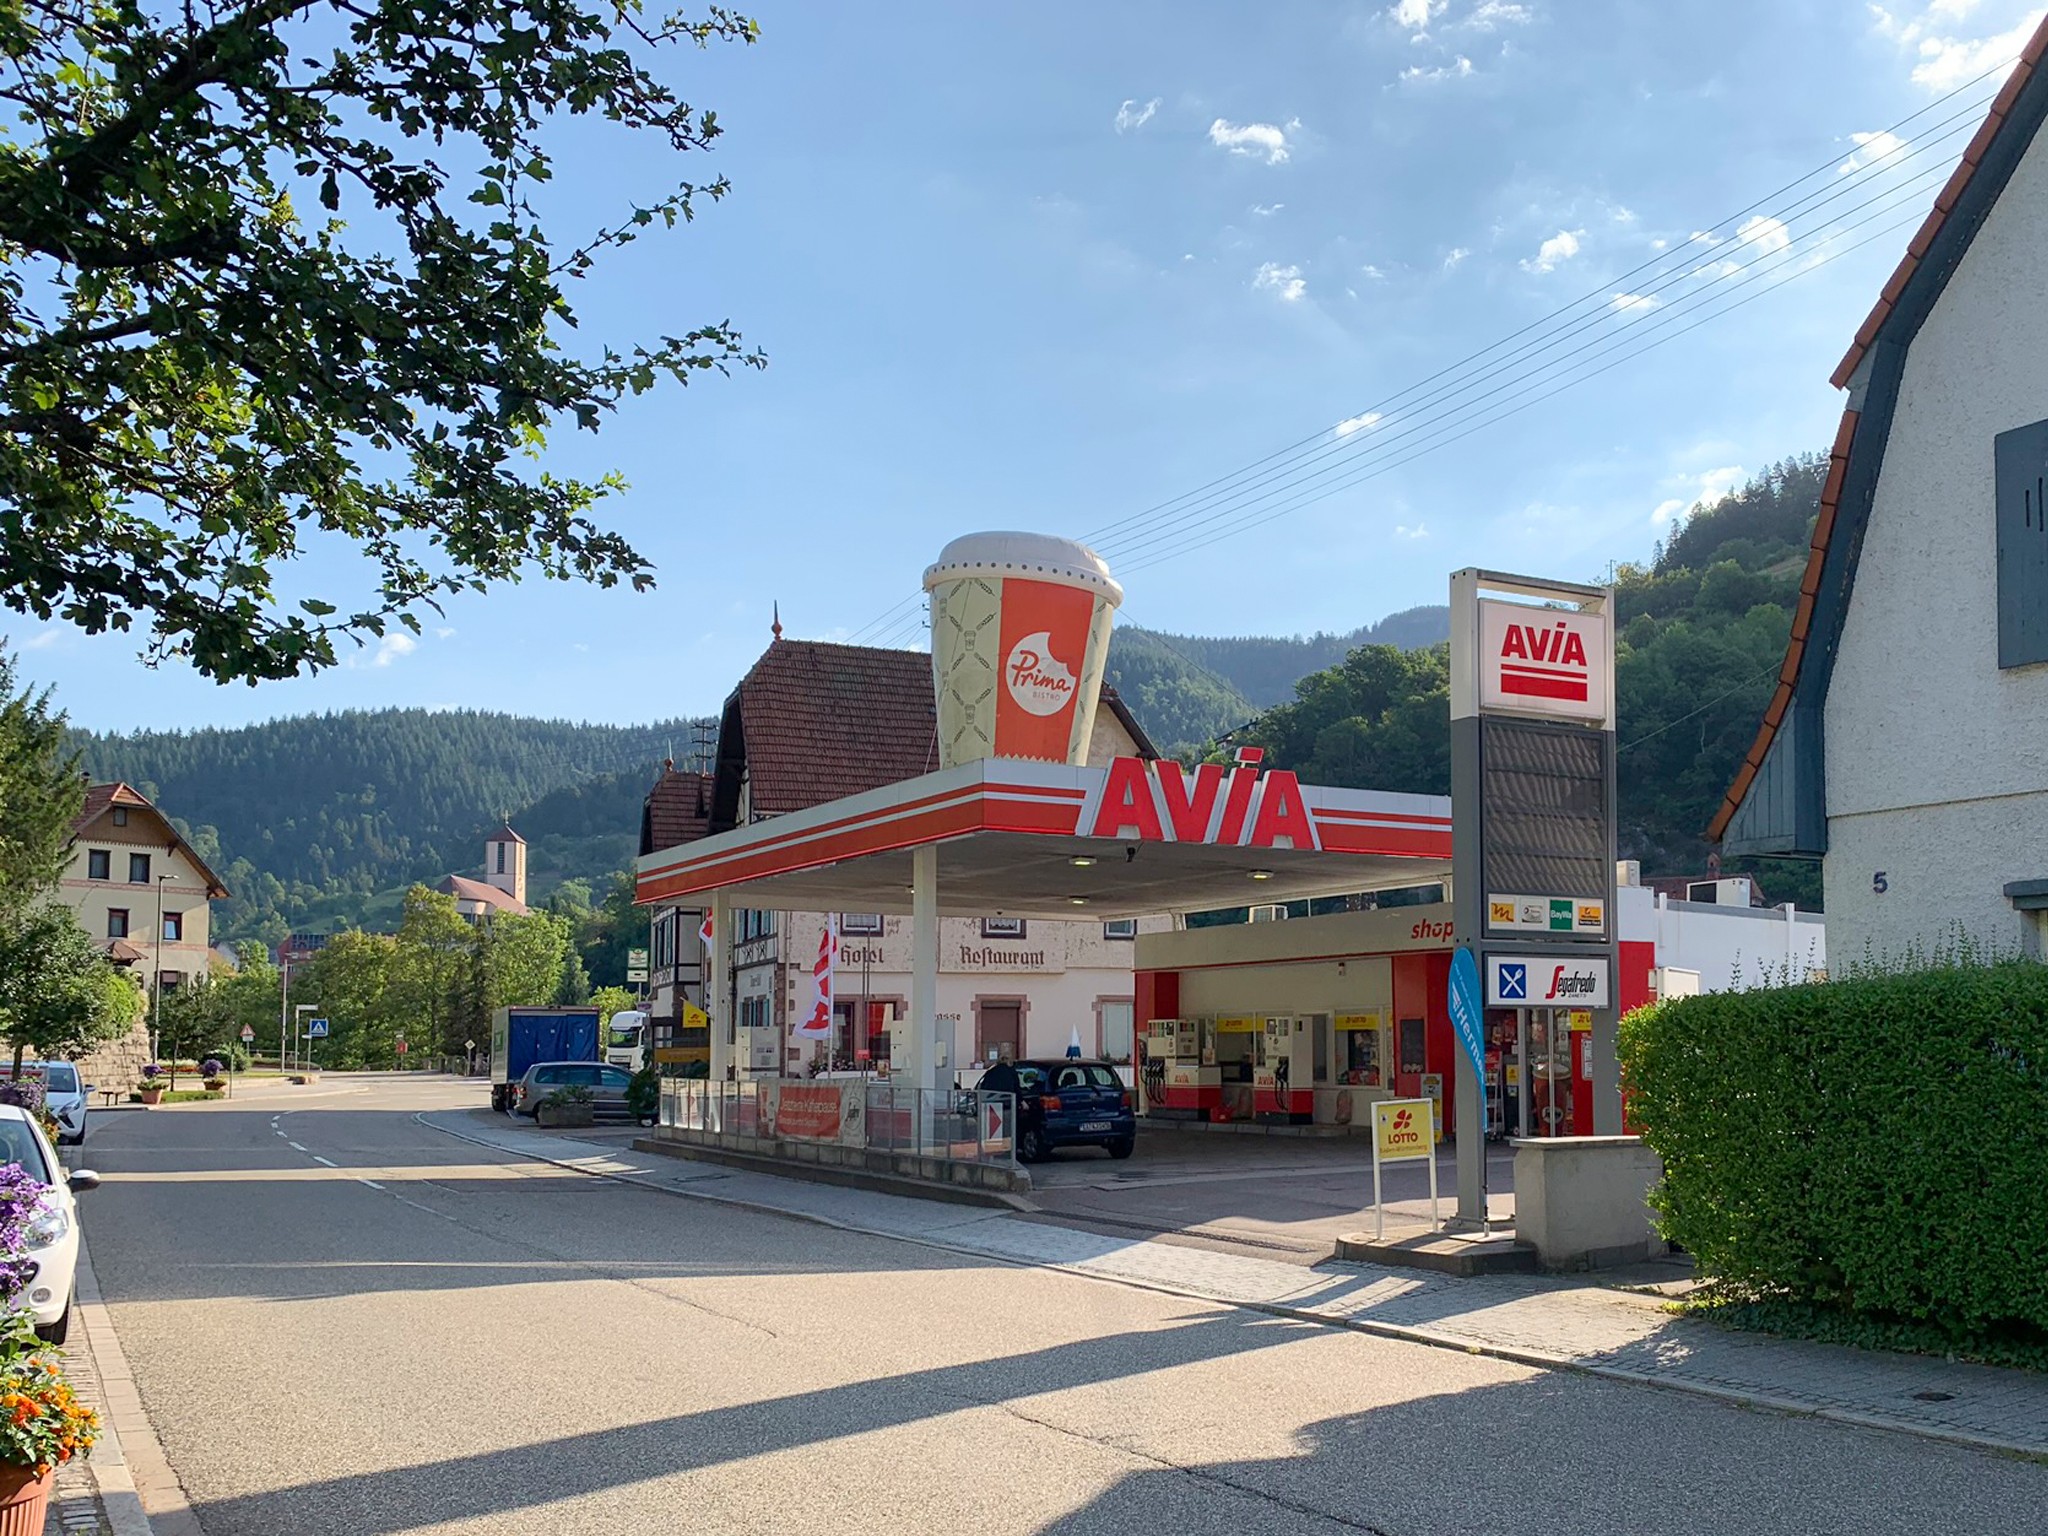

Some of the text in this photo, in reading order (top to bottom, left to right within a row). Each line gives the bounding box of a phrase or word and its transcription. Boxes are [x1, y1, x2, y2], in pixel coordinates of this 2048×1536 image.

[1501, 621, 1587, 666] AVIA
[1010, 649, 1071, 692] Prima
[1032, 691, 1061, 702] BISTRO
[1090, 746, 1321, 850] AVIA
[1873, 871, 1888, 894] 5
[1411, 918, 1454, 943] shop
[840, 945, 885, 966] Hotel
[1545, 965, 1597, 999] Segafredo
[1388, 1132, 1418, 1144] LOTTO
